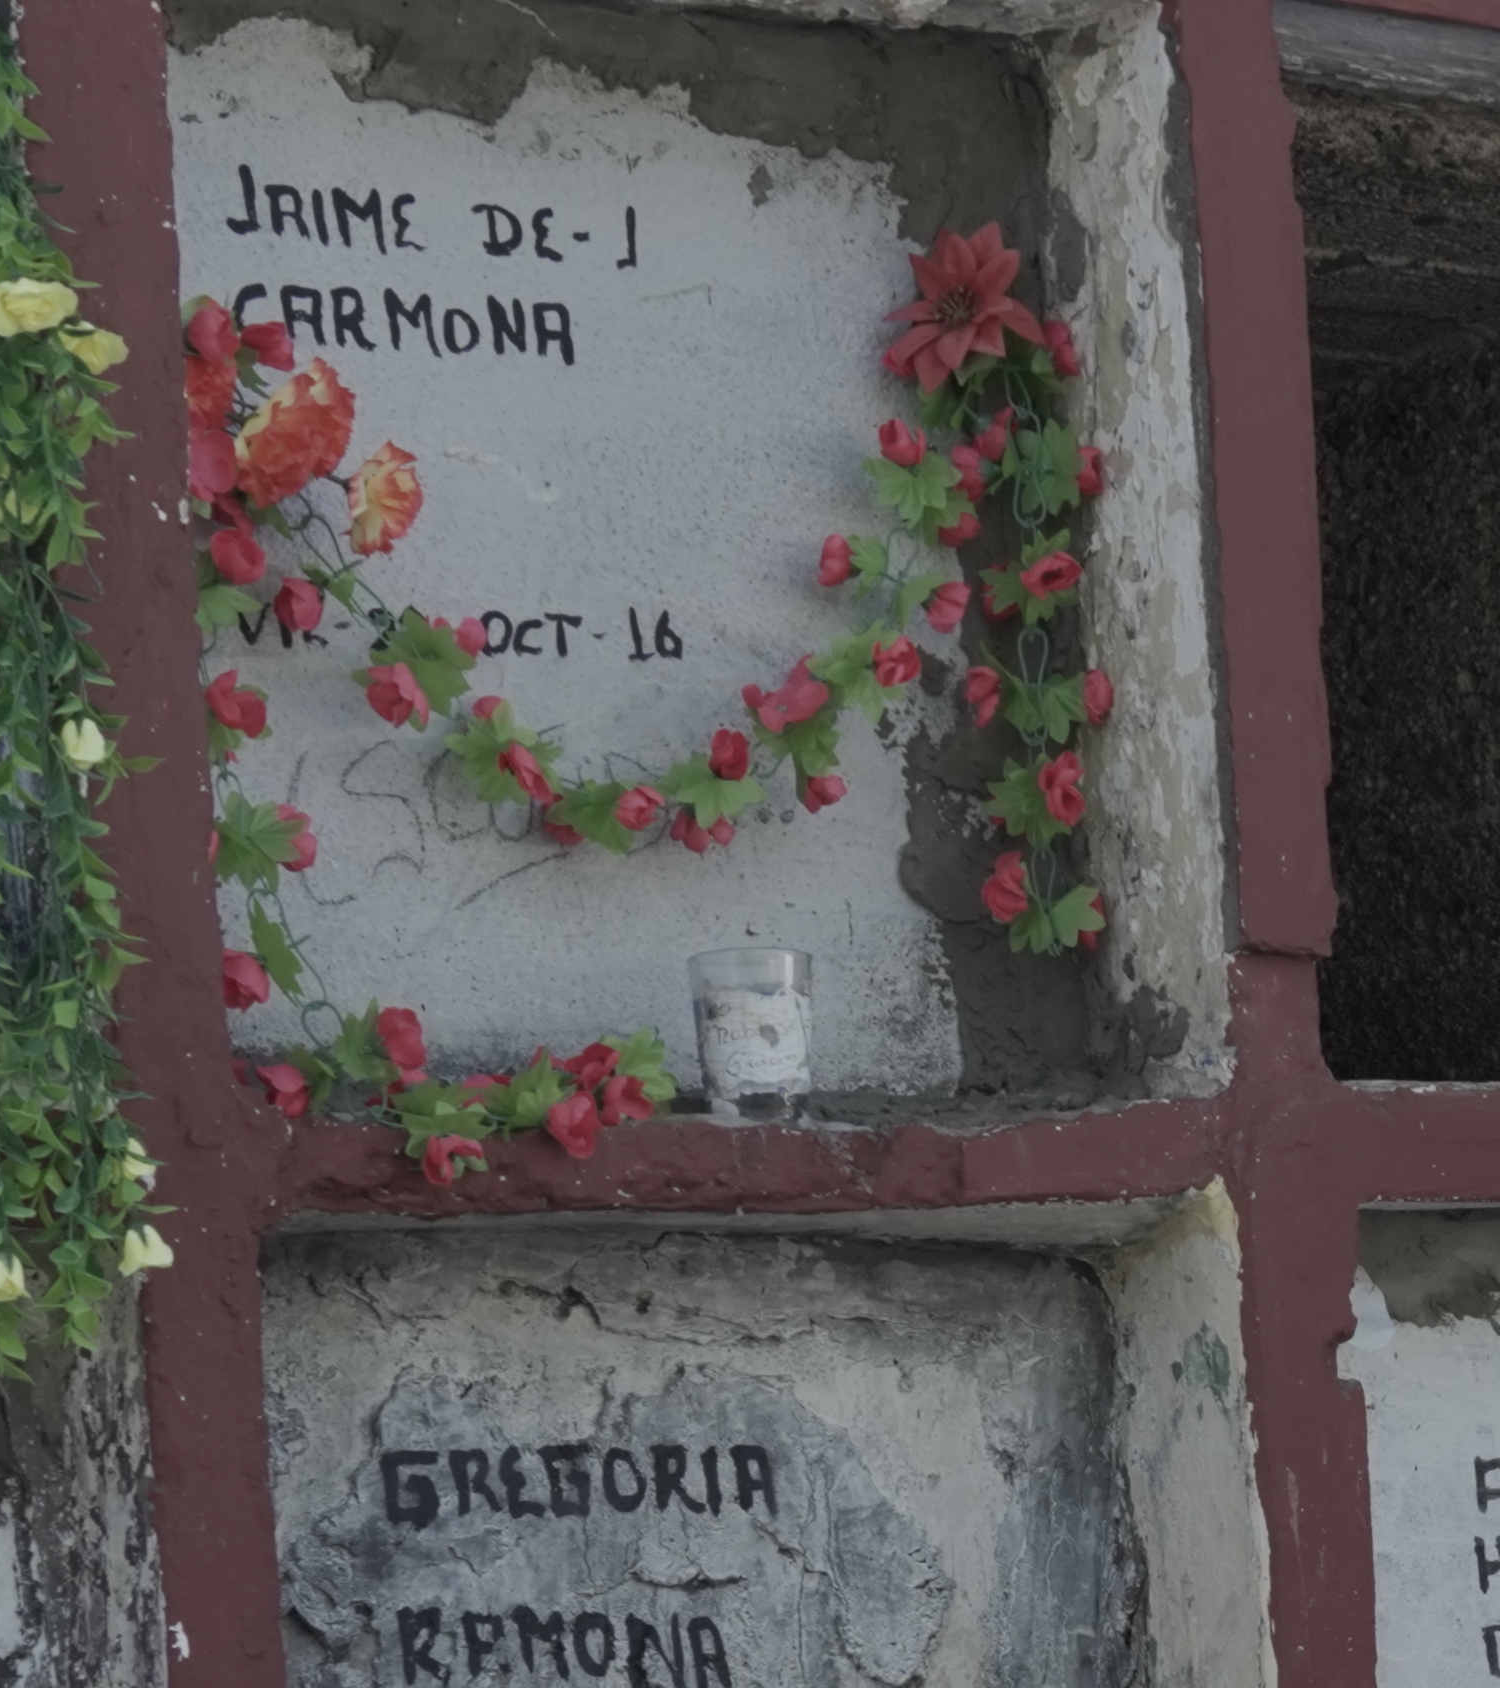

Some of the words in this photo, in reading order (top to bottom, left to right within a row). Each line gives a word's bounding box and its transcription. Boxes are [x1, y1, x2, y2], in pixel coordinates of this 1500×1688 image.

[226, 164, 427, 254] JAIME
[231, 283, 576, 367] CARMONA
[379, 1443, 782, 1530] GREGORIA
